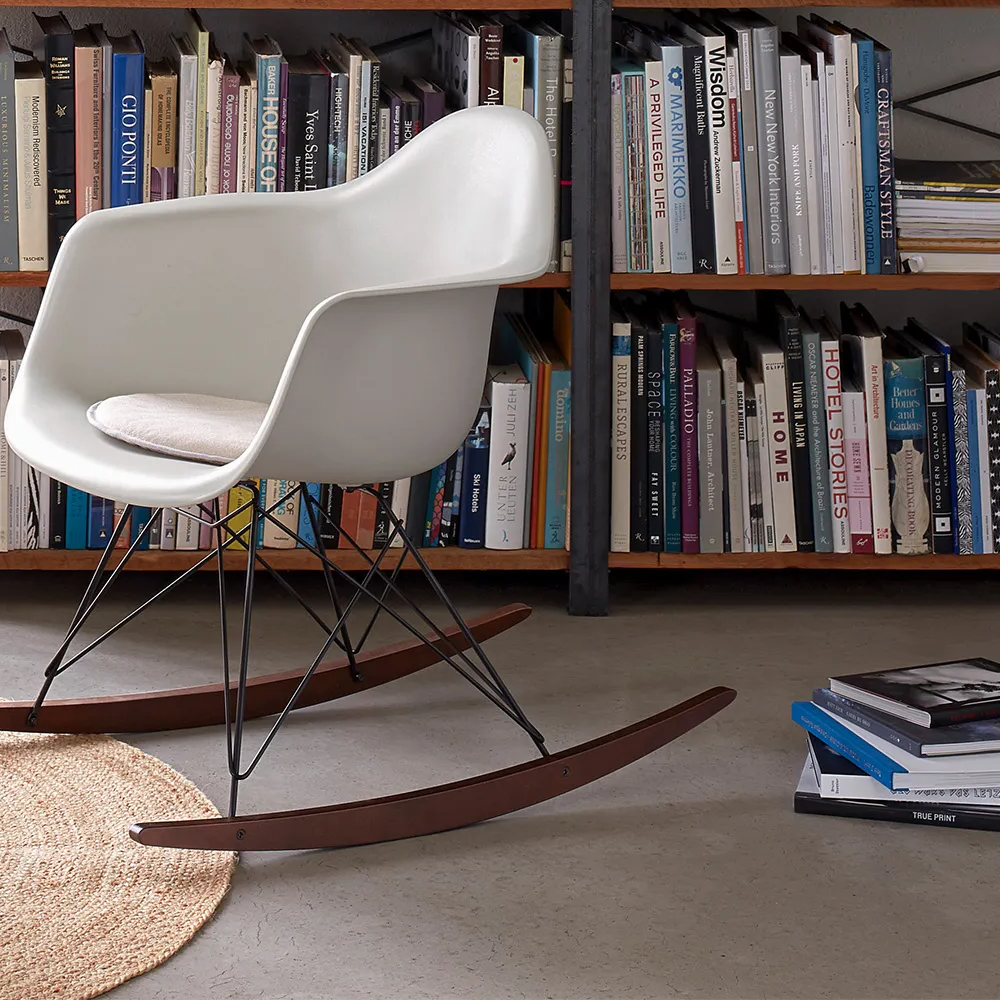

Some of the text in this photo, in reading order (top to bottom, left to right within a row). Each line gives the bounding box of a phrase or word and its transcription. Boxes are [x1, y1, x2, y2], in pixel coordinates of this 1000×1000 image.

[371, 65, 379, 97] Residential
[692, 55, 706, 135] Magnificent Baths
[860, 51, 871, 114] Hansgrohe DuMont
[260, 65, 279, 192] BAKER HOUSE OF
[305, 110, 319, 140] Yves
[370, 123, 378, 141] Today
[371, 98, 379, 122] Interiors
[545, 77, 558, 141] The Hotel
[708, 46, 726, 194] Wisdom Andrew Zuckerman
[0, 96, 10, 222] LUXURIOUS MINIMALISM
[31, 96, 41, 187] Modernism Rediscovered
[121, 95, 137, 184] GIO PONTI
[304, 144, 319, 180] Saint
[649, 78, 665, 219] A PRIVILEGED LIFE
[670, 94, 686, 198] MARIMEKKO
[791, 144, 800, 167] FORK
[877, 88, 892, 239] CRAFTSMAN STYLE
[764, 89, 782, 244] New New York Interiors
[793, 170, 801, 187] AND
[864, 185, 876, 264] Badewonnen
[506, 389, 517, 436] JULI ZEH
[554, 388, 567, 441] domino
[616, 364, 627, 460] RURAL ESCAPES
[669, 388, 677, 419] LIVING
[683, 368, 694, 434] PALLADIO
[792, 381, 806, 448] LIVING IN JAPAN
[891, 397, 920, 408] Homes
[893, 386, 917, 396] Better
[897, 408, 915, 419] and
[669, 434, 677, 472] COLOUR
[705, 433, 713, 468] Lautner,
[772, 411, 789, 482] HOME
[808, 342, 825, 511] OSCAR NIEMEYER and the Architecture of Brazil
[824, 348, 848, 519] HOTEL STORIES
[931, 411, 940, 460] GLAMOUR
[471, 474, 481, 513] Ski Hotels
[497, 476, 506, 522] UNTER
[507, 476, 517, 522] LEUTEN
[707, 472, 715, 511] Architect
[905, 449, 916, 536] DECORATING BOOK
[912, 811, 956, 822] TRUE PRINT
